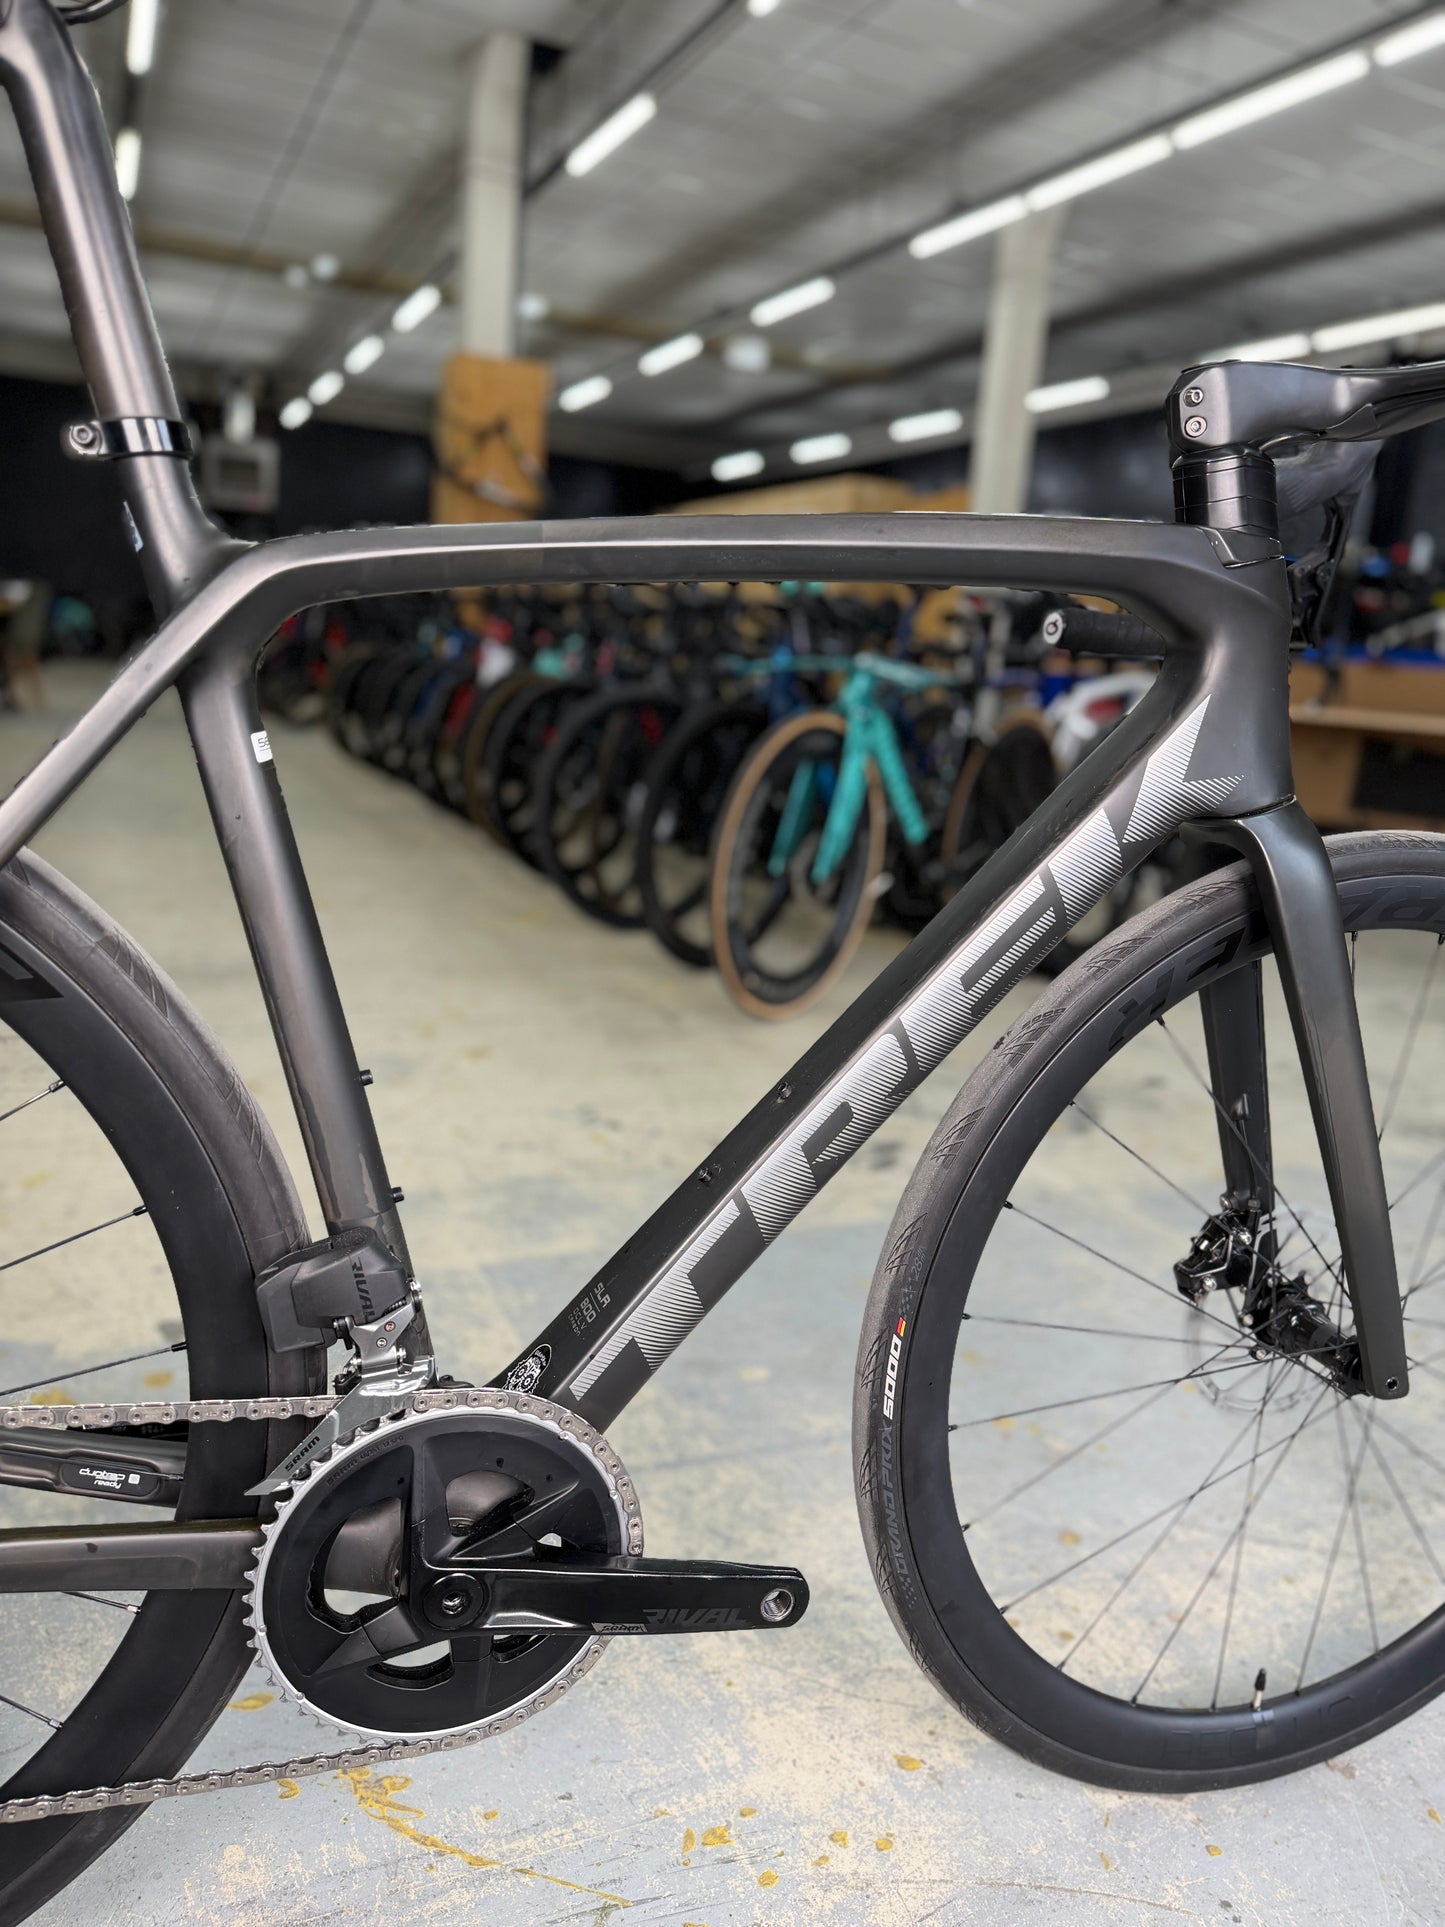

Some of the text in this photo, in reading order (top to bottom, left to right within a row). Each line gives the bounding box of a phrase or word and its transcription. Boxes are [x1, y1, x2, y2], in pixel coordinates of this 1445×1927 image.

[568, 693, 1245, 1401] TREK
[594, 1281, 611, 1308] SLR
[580, 1297, 597, 1323] 800
[284, 1435, 321, 1472] SRAM
[879, 1333, 909, 1575] GRAND PRIX 5000
[94, 1479, 122, 1489] ready
[601, 1623, 642, 1633] SRAM
[642, 1608, 748, 1626] RIVAL
